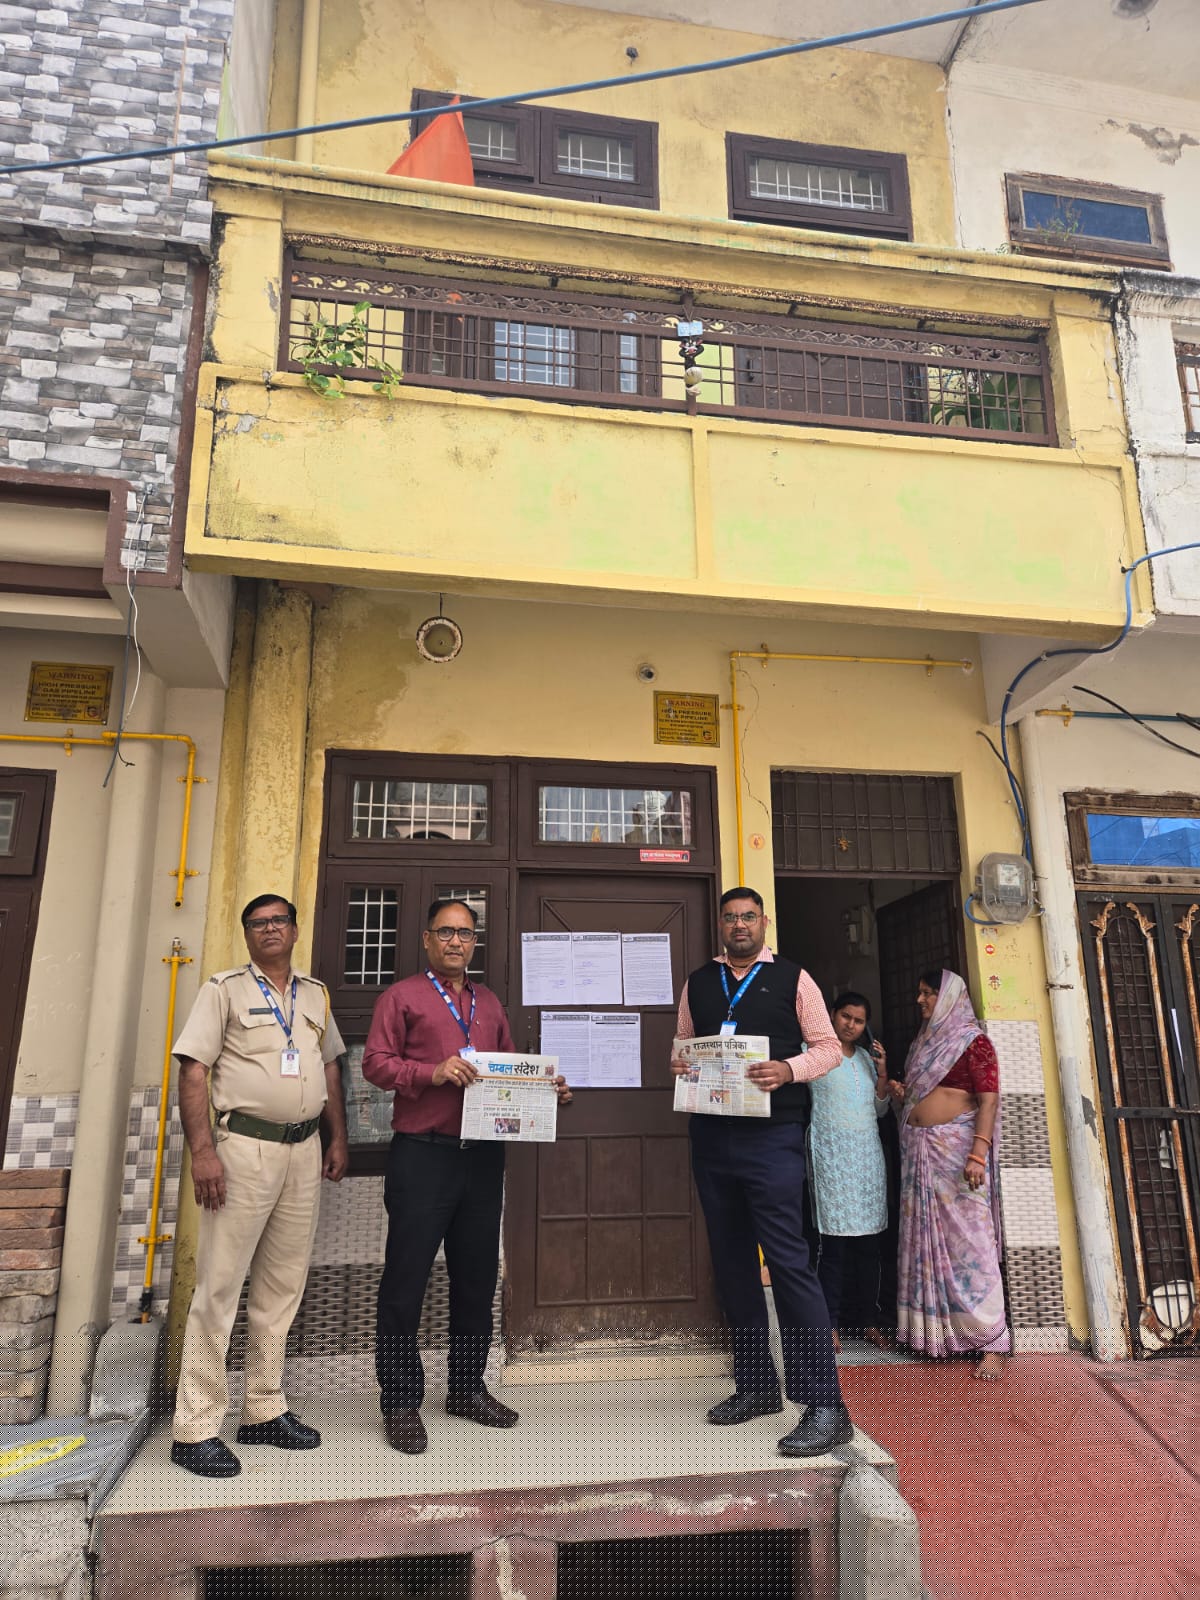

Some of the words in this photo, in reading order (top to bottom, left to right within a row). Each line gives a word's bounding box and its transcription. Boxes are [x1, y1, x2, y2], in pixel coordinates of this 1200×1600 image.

[49, 671, 95, 681] WARNING
[667, 699, 705, 708] WARNING
[693, 1040, 722, 1051] राजस्थान
[724, 1038, 747, 1051] पत्रिका
[487, 1063, 513, 1074] चम्बल
[513, 1061, 540, 1076] संदेश
